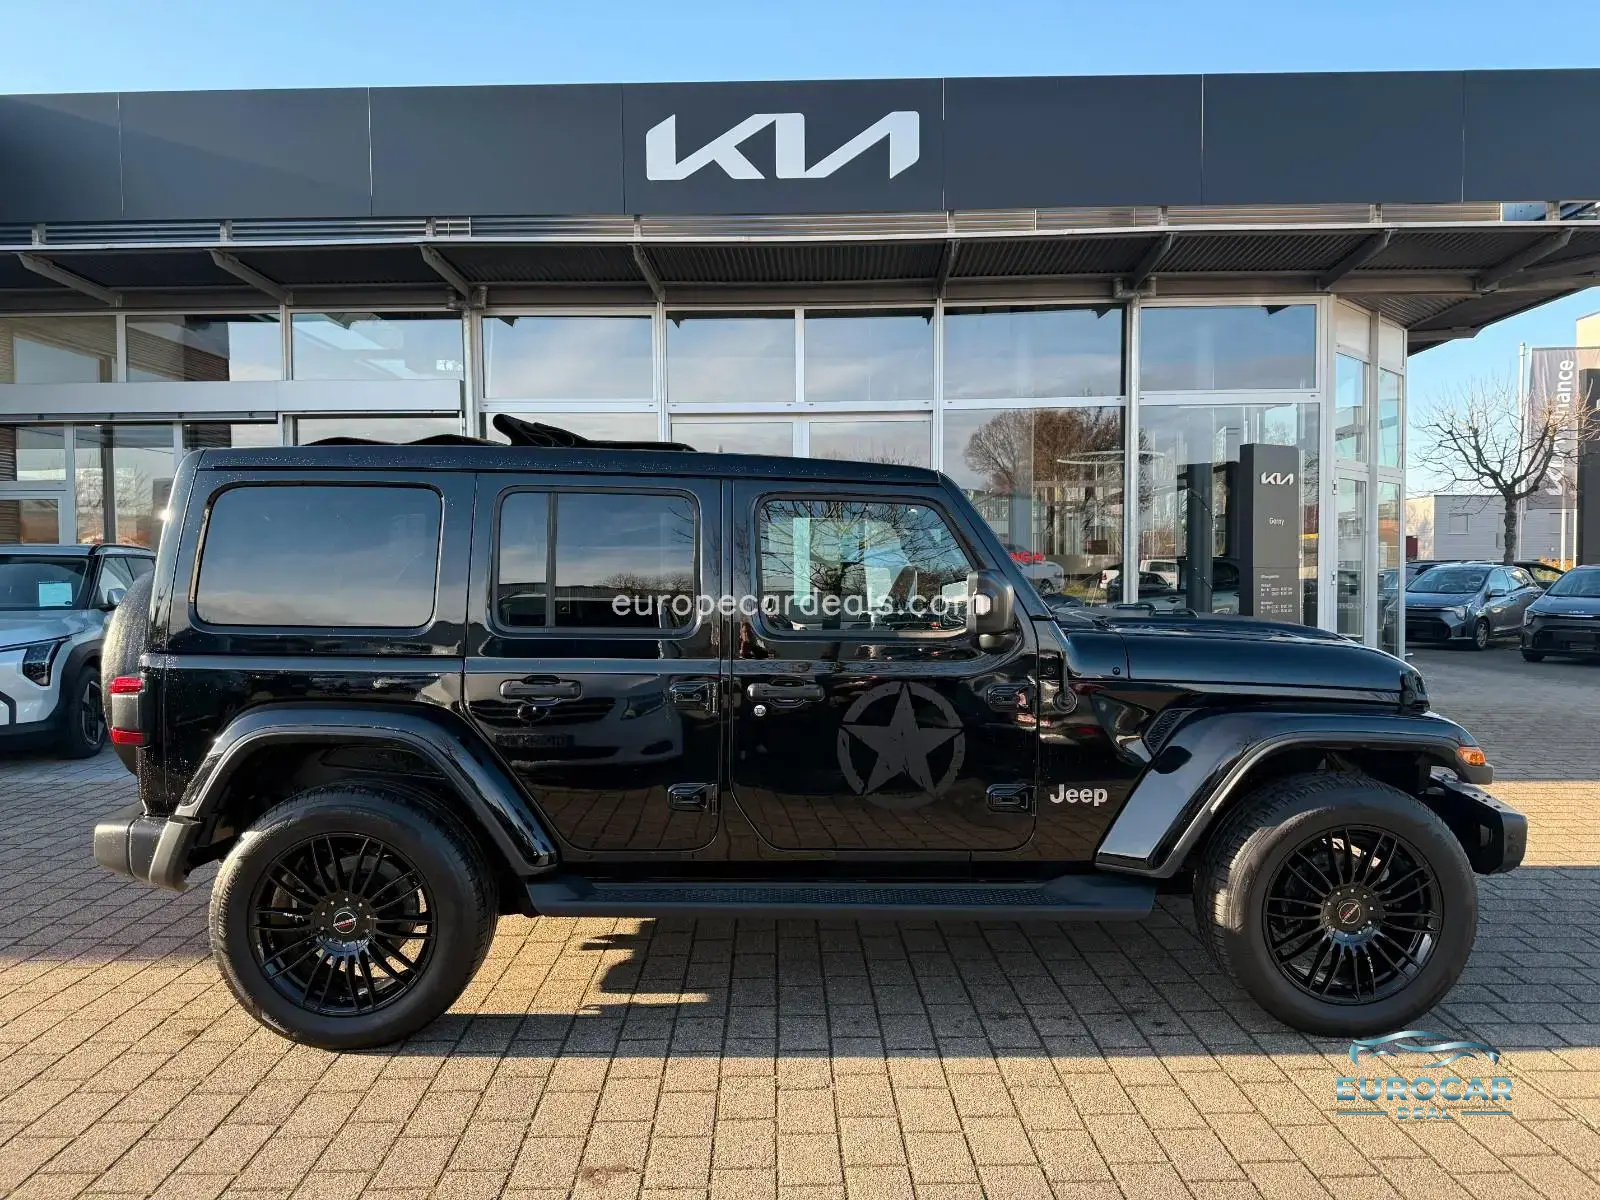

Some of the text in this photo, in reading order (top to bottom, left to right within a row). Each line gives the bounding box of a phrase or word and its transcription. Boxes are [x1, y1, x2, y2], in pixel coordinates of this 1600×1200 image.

[646, 110, 920, 180] KIA
[1261, 471, 1294, 485] KIA
[1049, 783, 1108, 807] Jeep
